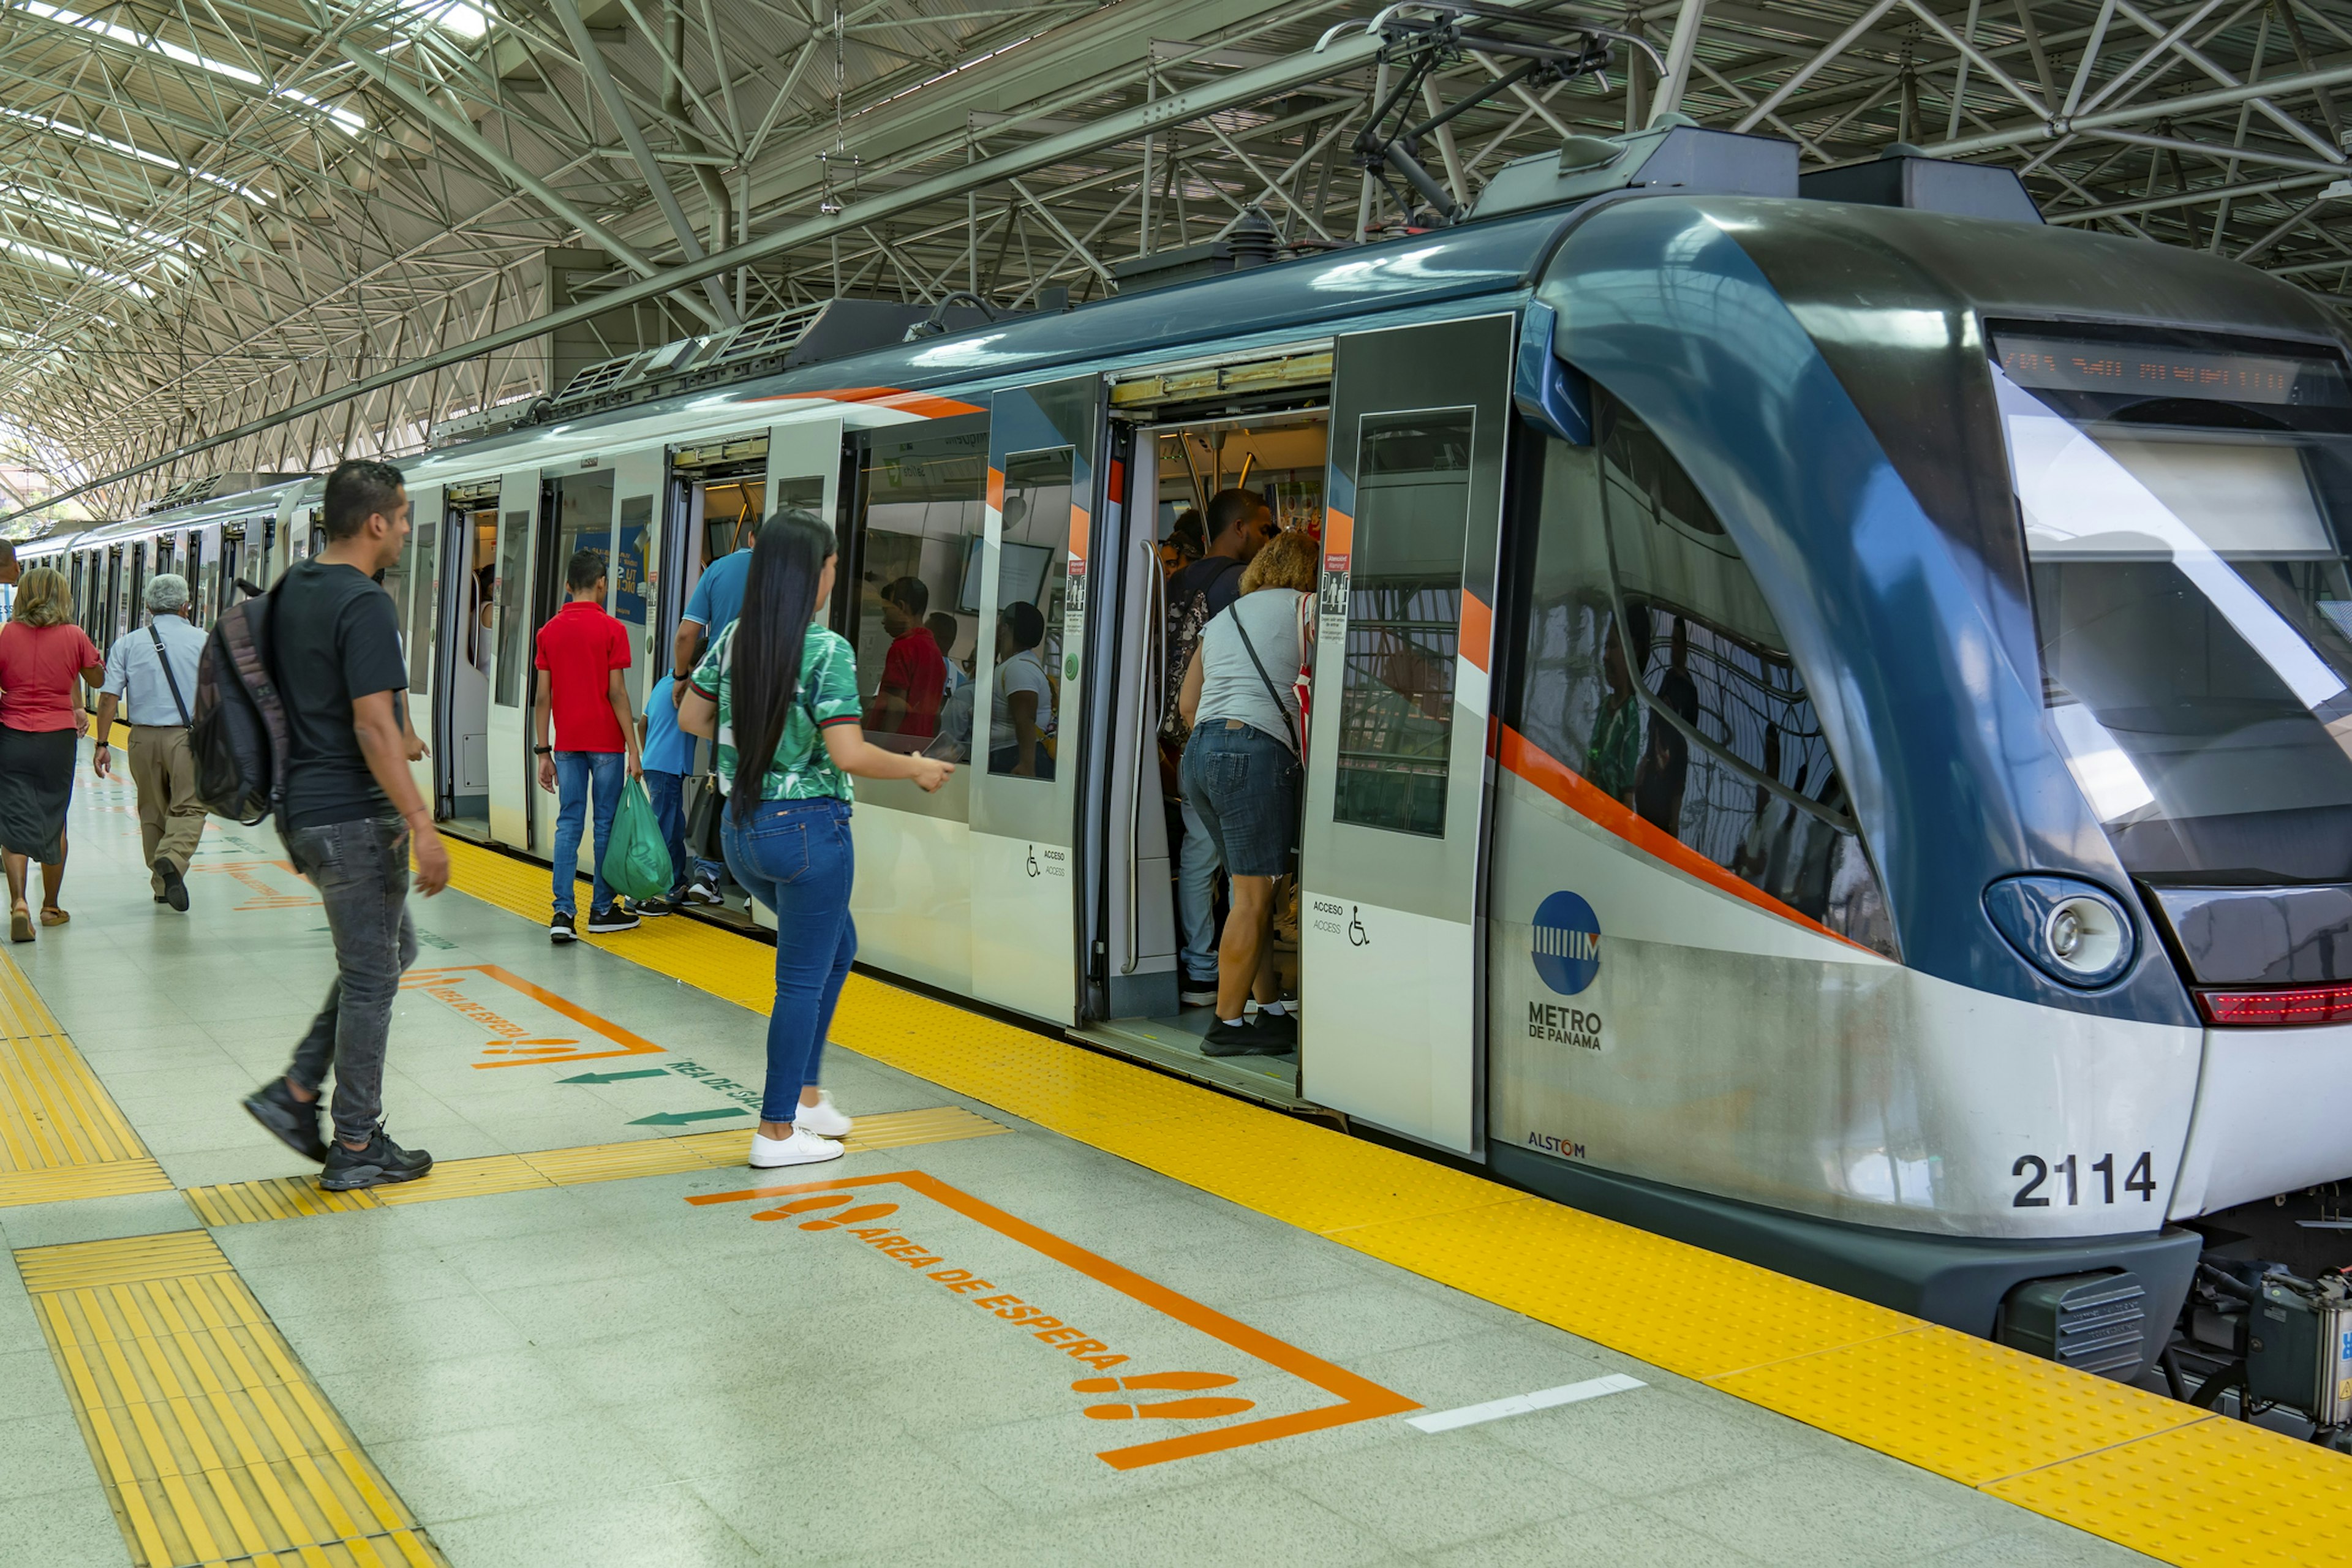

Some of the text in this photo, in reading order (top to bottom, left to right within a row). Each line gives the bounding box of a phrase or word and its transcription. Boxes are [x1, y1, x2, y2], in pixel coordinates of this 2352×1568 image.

[1044, 850, 1065, 861] ACCESO
[1046, 865, 1065, 876] ACCESS
[1314, 901, 1343, 916] ACCESO
[1313, 919, 1341, 934] ACCESS
[451, 1002, 486, 1012] DE
[467, 1012, 532, 1039] ESPERA
[1529, 1001, 1602, 1035] METRO
[1529, 1025, 1601, 1051] DE PANAMA
[699, 1078, 744, 1091] DE
[1529, 1132, 1585, 1159] ALSTOM
[2013, 1152, 2156, 1208] 2114
[846, 1227, 1131, 1371] ÁREA DE ESPERA
